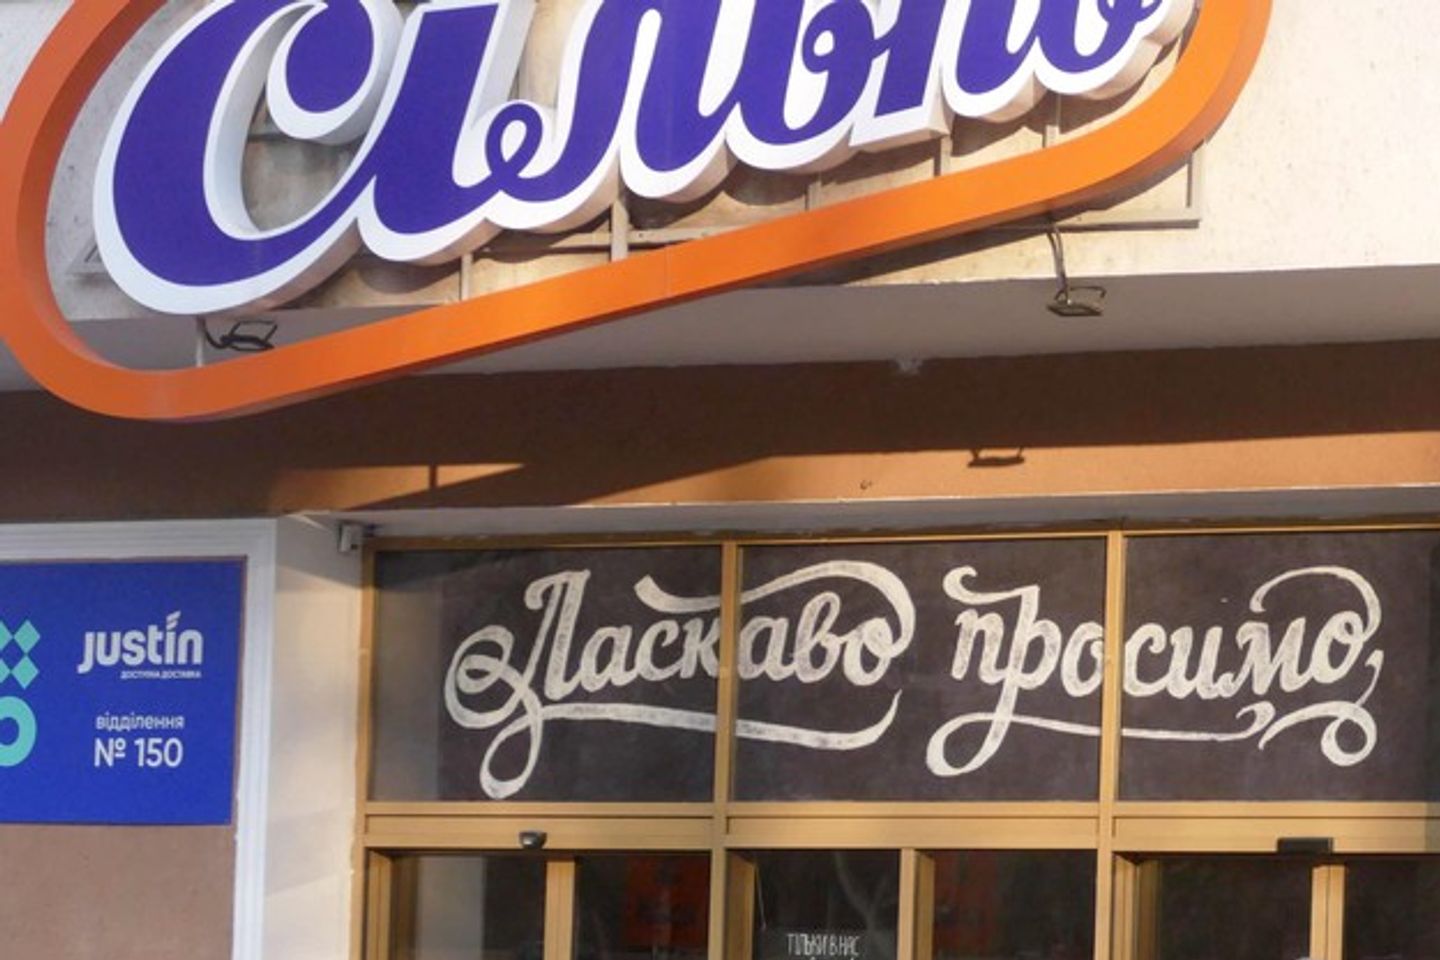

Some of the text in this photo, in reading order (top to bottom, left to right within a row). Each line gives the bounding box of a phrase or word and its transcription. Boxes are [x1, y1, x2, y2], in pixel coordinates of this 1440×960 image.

[444, 559, 1384, 798] Ласкаво просимо
[96, 711, 184, 731] відділення
[134, 738, 183, 767] 150
